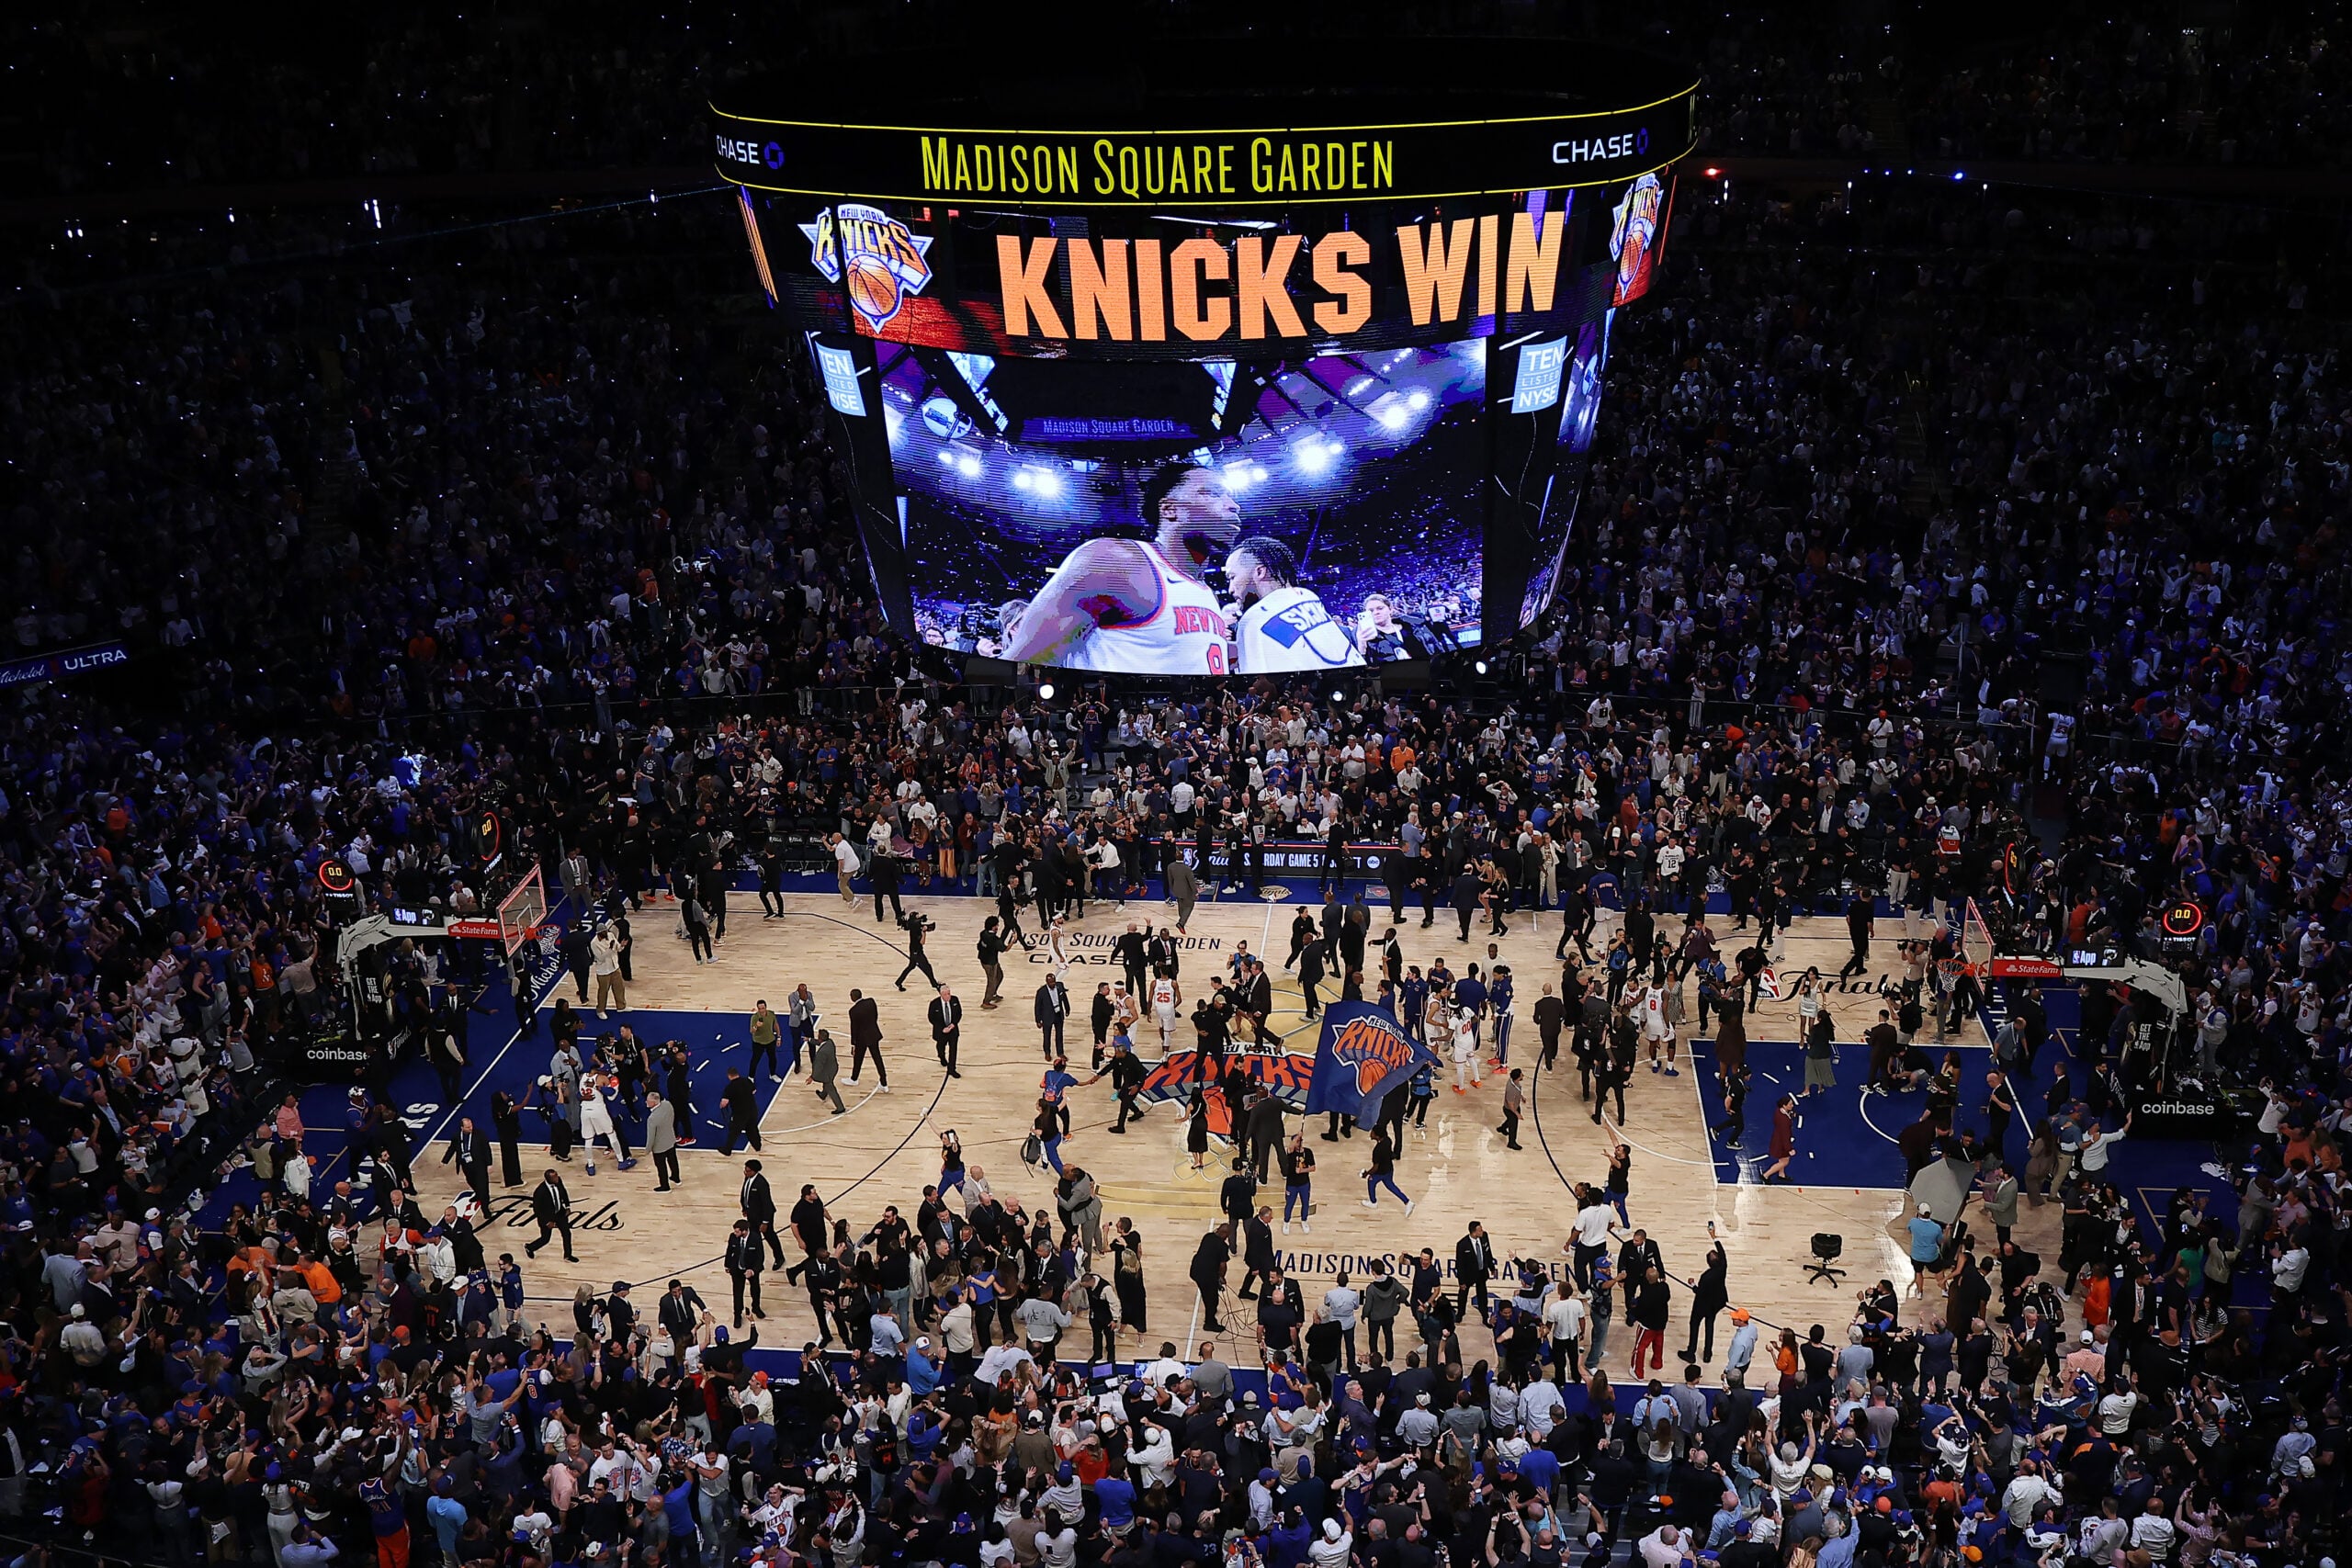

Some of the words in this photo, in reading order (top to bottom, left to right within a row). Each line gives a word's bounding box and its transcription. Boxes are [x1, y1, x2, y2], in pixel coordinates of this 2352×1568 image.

[717, 134, 760, 164] CHASE
[1552, 133, 1634, 164] CHASE
[815, 215, 928, 276] KNICKS
[996, 231, 1372, 341] KNICKS
[1396, 211, 1565, 326] WIN
[1526, 344, 1565, 372] TEN
[1521, 370, 1560, 387] LISTED
[1518, 385, 1558, 408] NYSE
[64, 649, 128, 671] ULTRA
[1288, 853, 1312, 868] GAME
[1312, 854, 1319, 868] 5
[1668, 859, 1677, 869] 12
[327, 867, 343, 876] 0.0
[401, 910, 418, 925] App
[2175, 908, 2191, 919] 0.0
[2079, 951, 2097, 964] App
[366, 976, 377, 987] GET
[367, 986, 379, 994] THE
[1157, 992, 1170, 1004] 25
[1650, 999, 1657, 1010] 8
[1367, 1016, 1390, 1029] NEW
[1461, 1021, 1473, 1035] 00
[2140, 1023, 2152, 1032] GET
[2139, 1032, 2151, 1042] THE
[2138, 1043, 2152, 1052] App
[2142, 1100, 2215, 1115] coinbase
